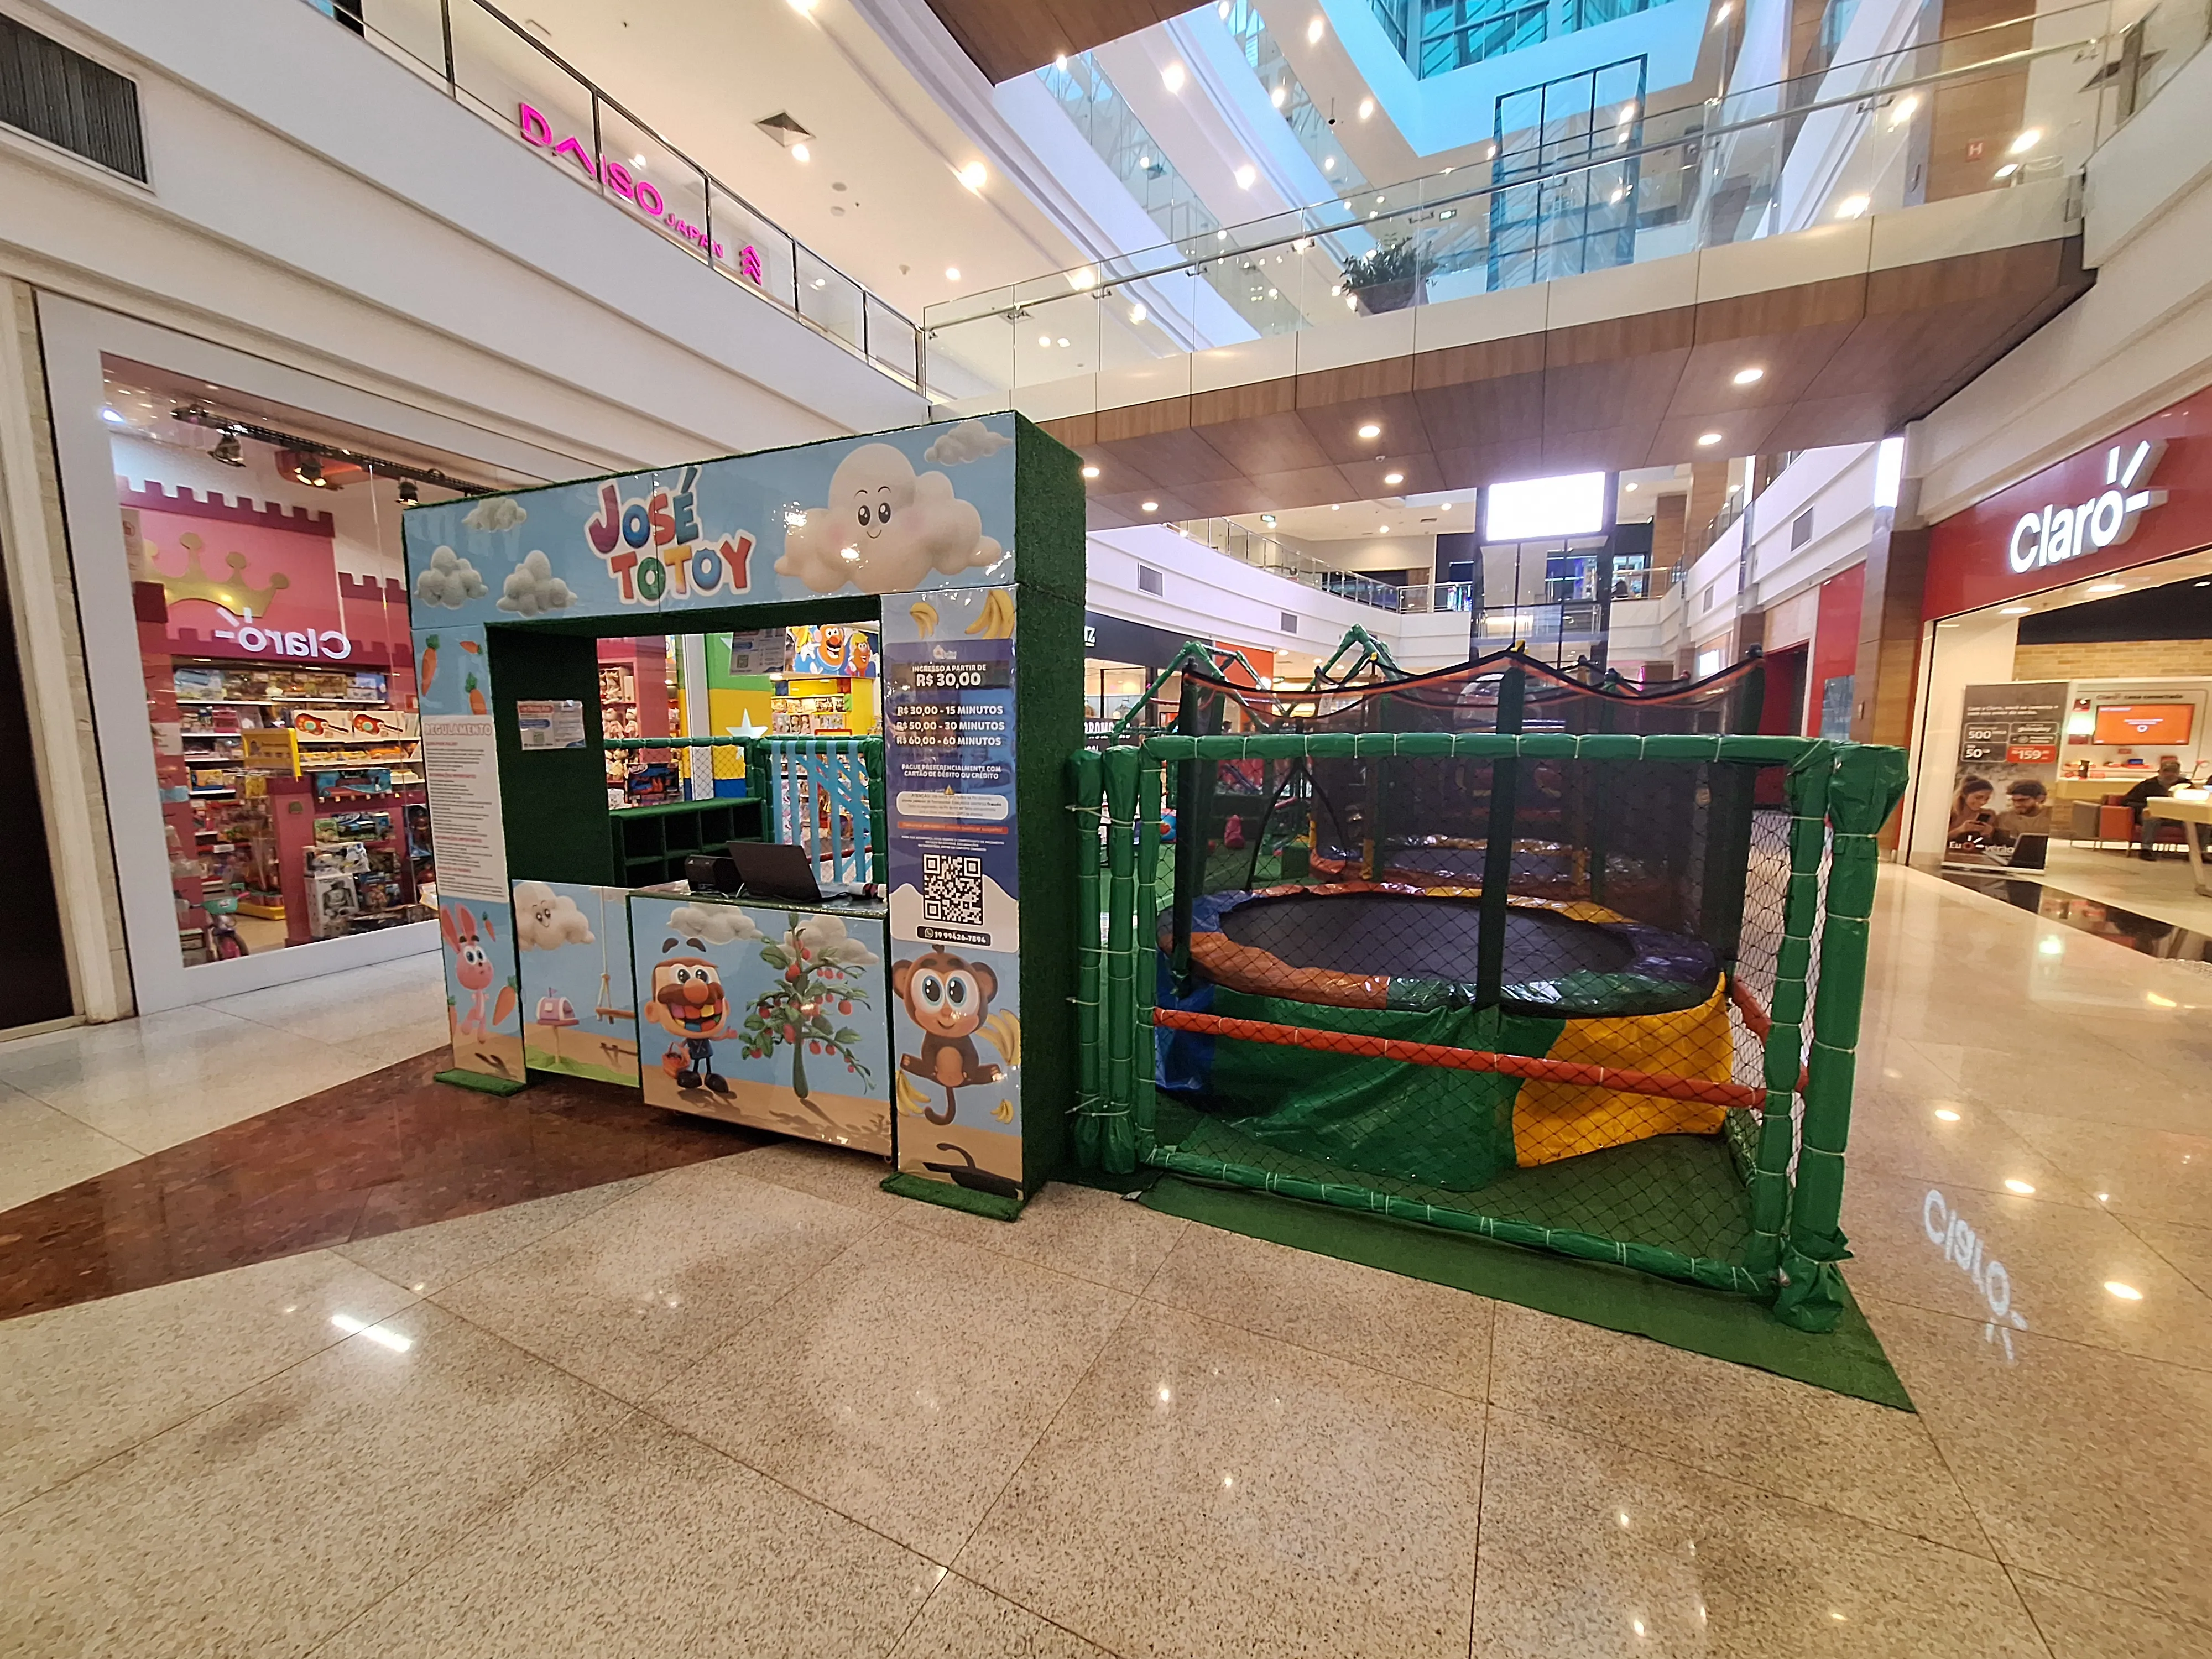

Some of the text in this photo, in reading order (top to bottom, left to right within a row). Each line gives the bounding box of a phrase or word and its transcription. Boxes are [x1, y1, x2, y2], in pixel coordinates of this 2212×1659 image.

[520, 102, 724, 258] DAISO JAPAN
[588, 466, 700, 554] JOSÉ
[2010, 490, 2123, 573] Claro
[611, 536, 752, 600] TOTOY
[916, 672, 982, 690] R$ 30,00
[898, 706, 908, 716] R$
[910, 706, 938, 717] 30,00
[946, 706, 956, 714] 15
[957, 706, 1004, 715] MINUTOS
[424, 723, 493, 737] REGULAMENTO
[896, 721, 907, 731] R$
[909, 721, 937, 732] 50,00
[945, 722, 957, 730] 30
[959, 722, 1005, 731] MINUTOS
[896, 737, 907, 745] R$
[909, 736, 936, 747] 60,00
[943, 736, 956, 745] 60
[957, 737, 1001, 745] MINUTOS
[922, 764, 985, 773] PREFERENCIALMENTE
[937, 770, 959, 779] DÉBITO
[971, 771, 999, 780] CRÉDITO
